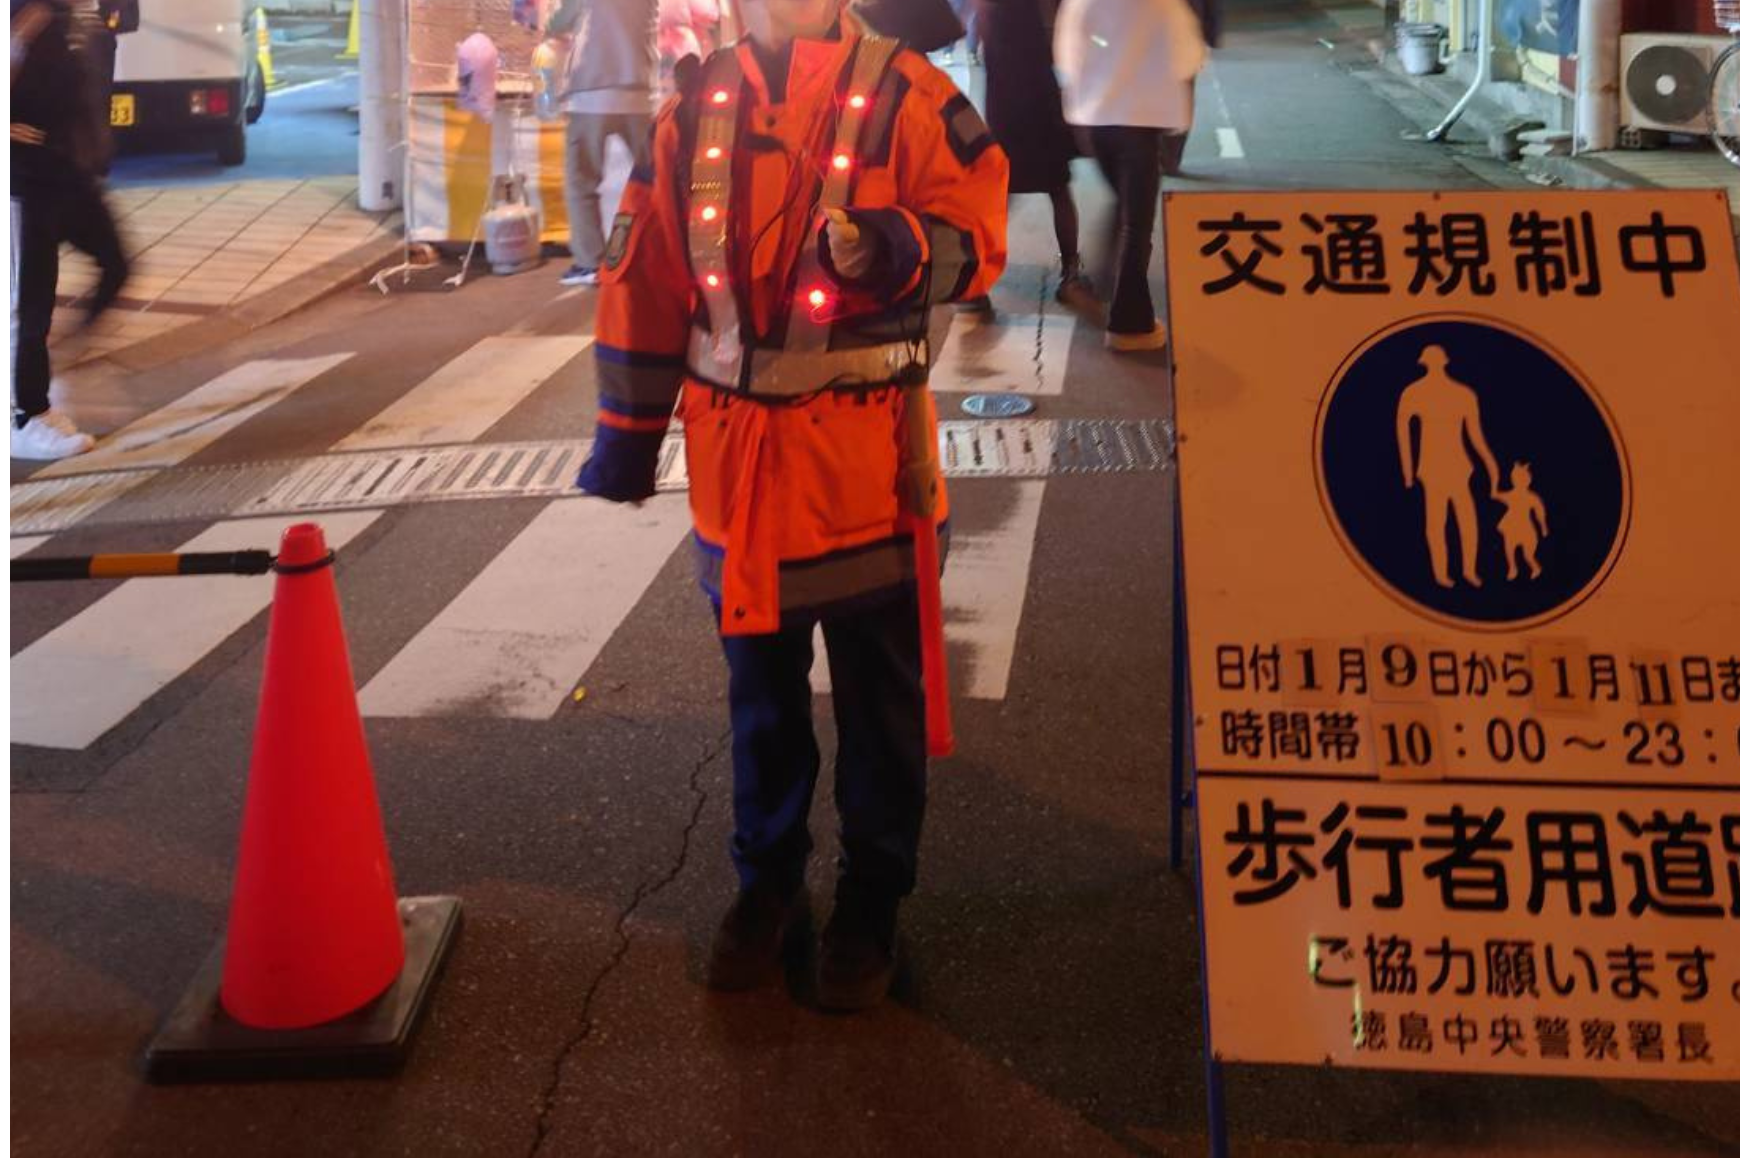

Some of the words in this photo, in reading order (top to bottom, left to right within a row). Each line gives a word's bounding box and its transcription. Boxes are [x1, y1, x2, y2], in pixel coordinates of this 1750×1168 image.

[1197, 211, 1706, 299] 交通規制中
[1350, 1008, 1716, 1066] 徳島中央警察署長
